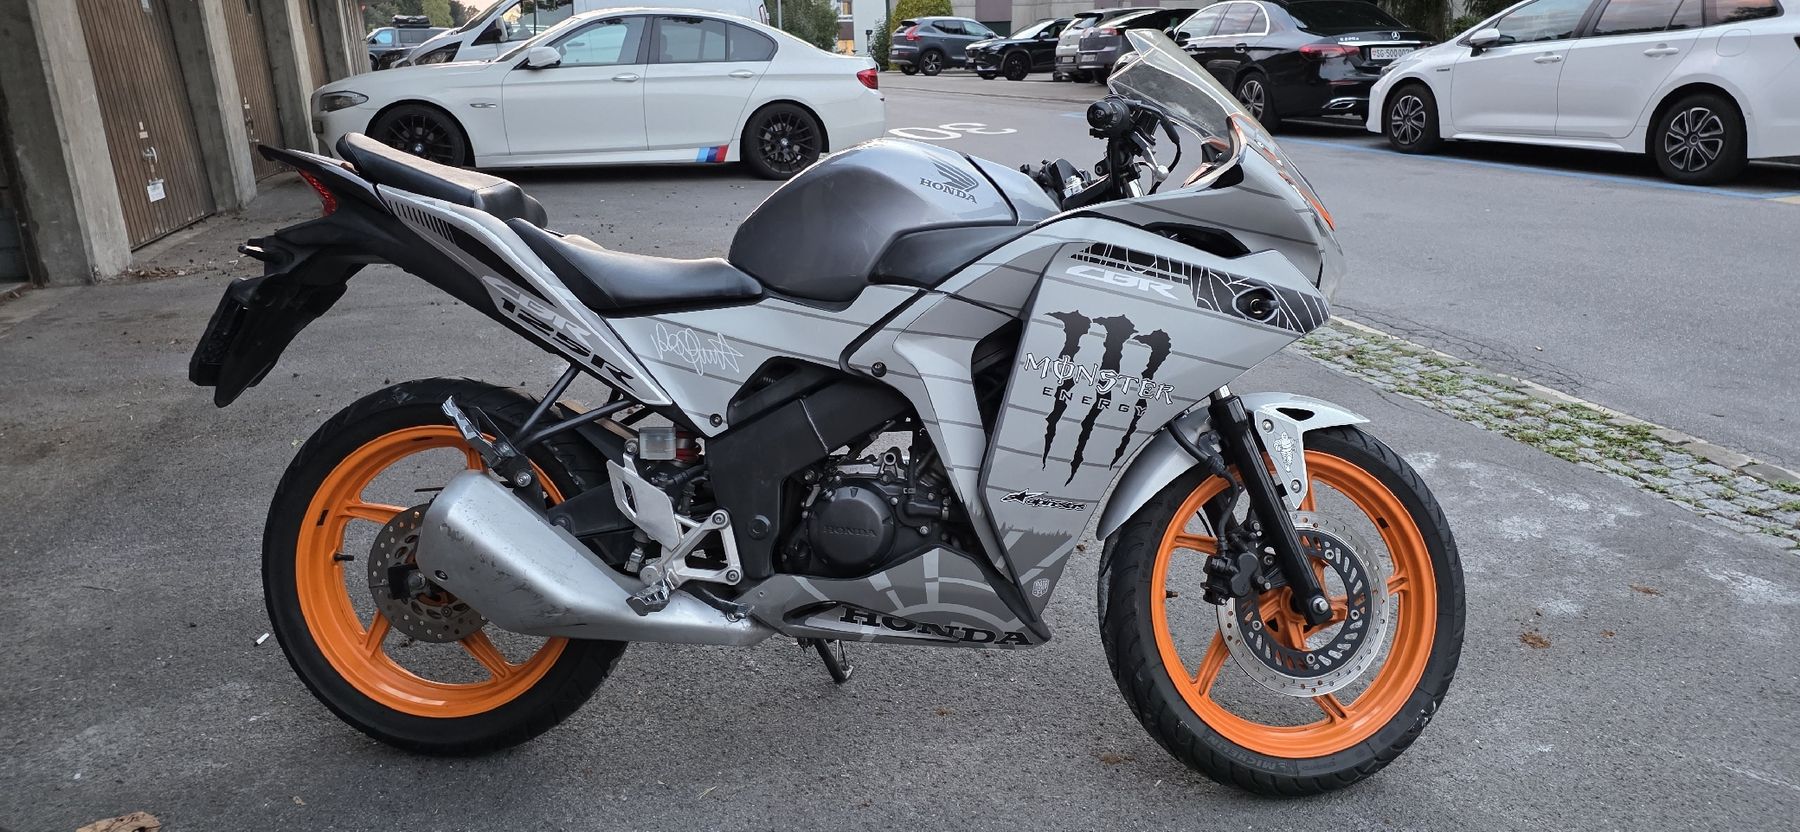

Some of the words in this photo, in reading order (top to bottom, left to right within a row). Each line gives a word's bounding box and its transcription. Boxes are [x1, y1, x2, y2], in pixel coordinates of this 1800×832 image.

[920, 177, 978, 204] HONDA
[1065, 265, 1179, 300] CBR
[482, 275, 595, 350] CBR
[501, 297, 637, 393] 125R
[1042, 386, 1148, 416] ENERGY
[823, 525, 878, 537] HONDA
[839, 604, 1034, 646] HONDA
[1207, 735, 1277, 770] MICHELIN
